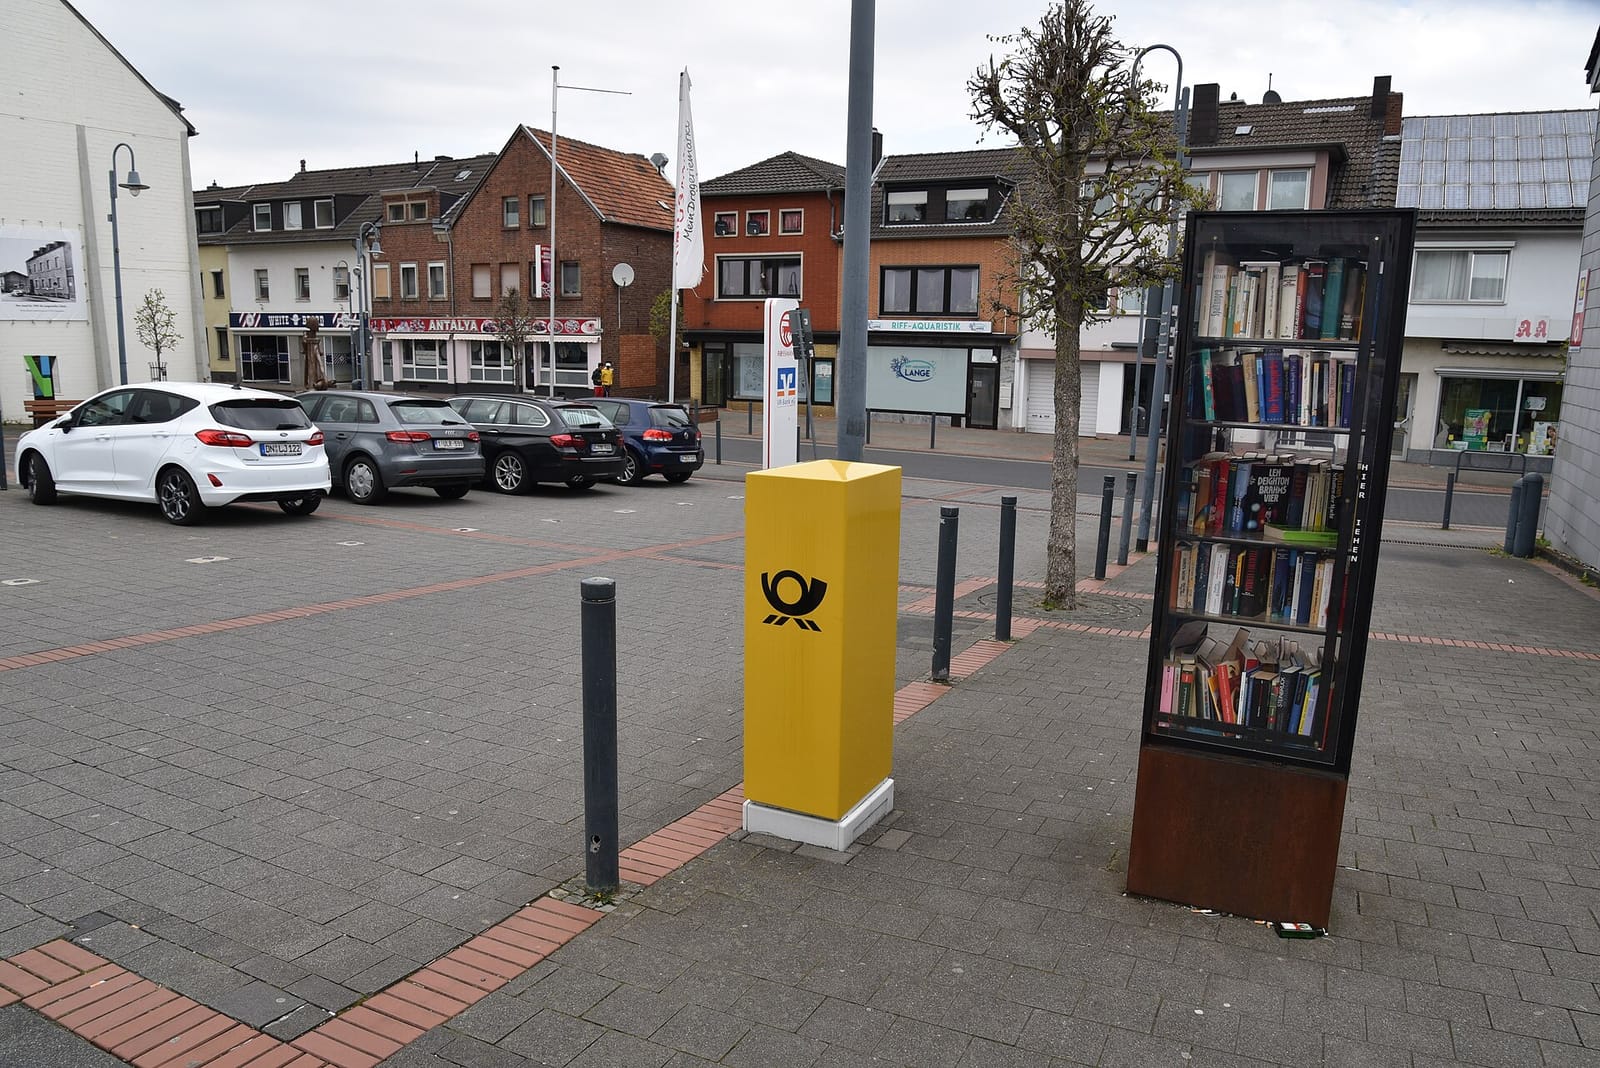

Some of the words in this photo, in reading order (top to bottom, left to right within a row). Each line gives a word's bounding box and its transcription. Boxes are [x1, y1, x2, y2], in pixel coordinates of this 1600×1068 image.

[268, 315, 289, 326] WHITE
[428, 319, 479, 332] ANTALYA
[891, 321, 961, 331] RIFF-AQUARISTIK
[904, 369, 931, 378] LANGE
[1257, 476, 1290, 486] DEIGHTON
[1358, 463, 1369, 499] HIER
[1263, 494, 1279, 503] VIER
